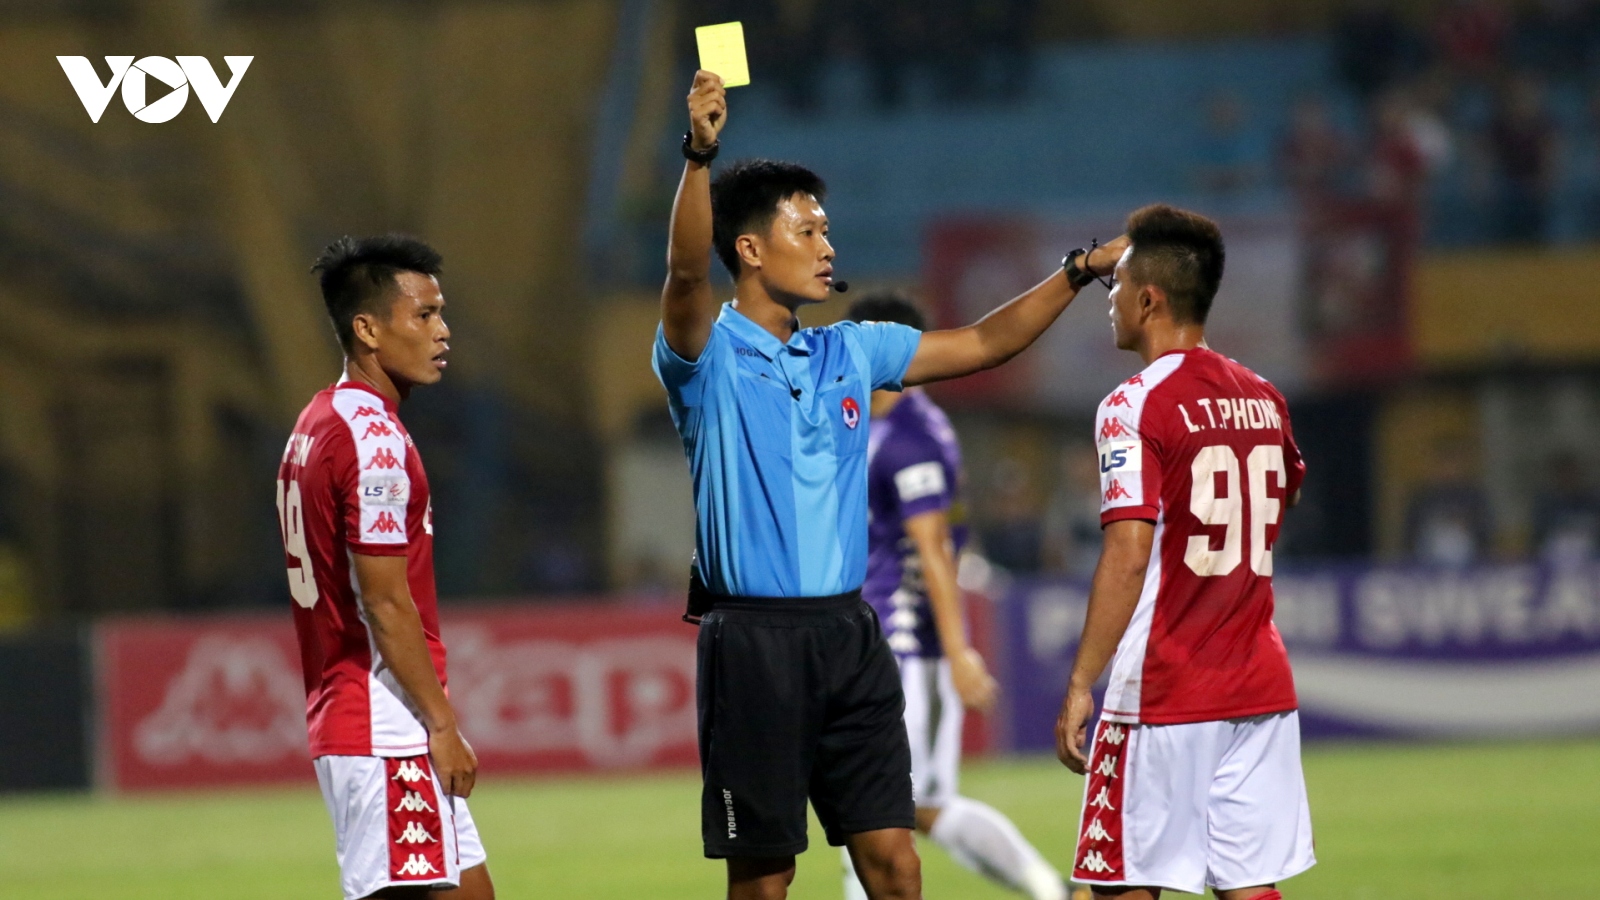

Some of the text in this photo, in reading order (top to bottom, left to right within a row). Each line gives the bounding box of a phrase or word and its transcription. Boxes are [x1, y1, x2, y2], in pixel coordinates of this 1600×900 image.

[1101, 448, 1127, 473] LS
[364, 486, 384, 497] LS
[1184, 444, 1286, 576] 96
[722, 789, 737, 839] JOGARBOLA
